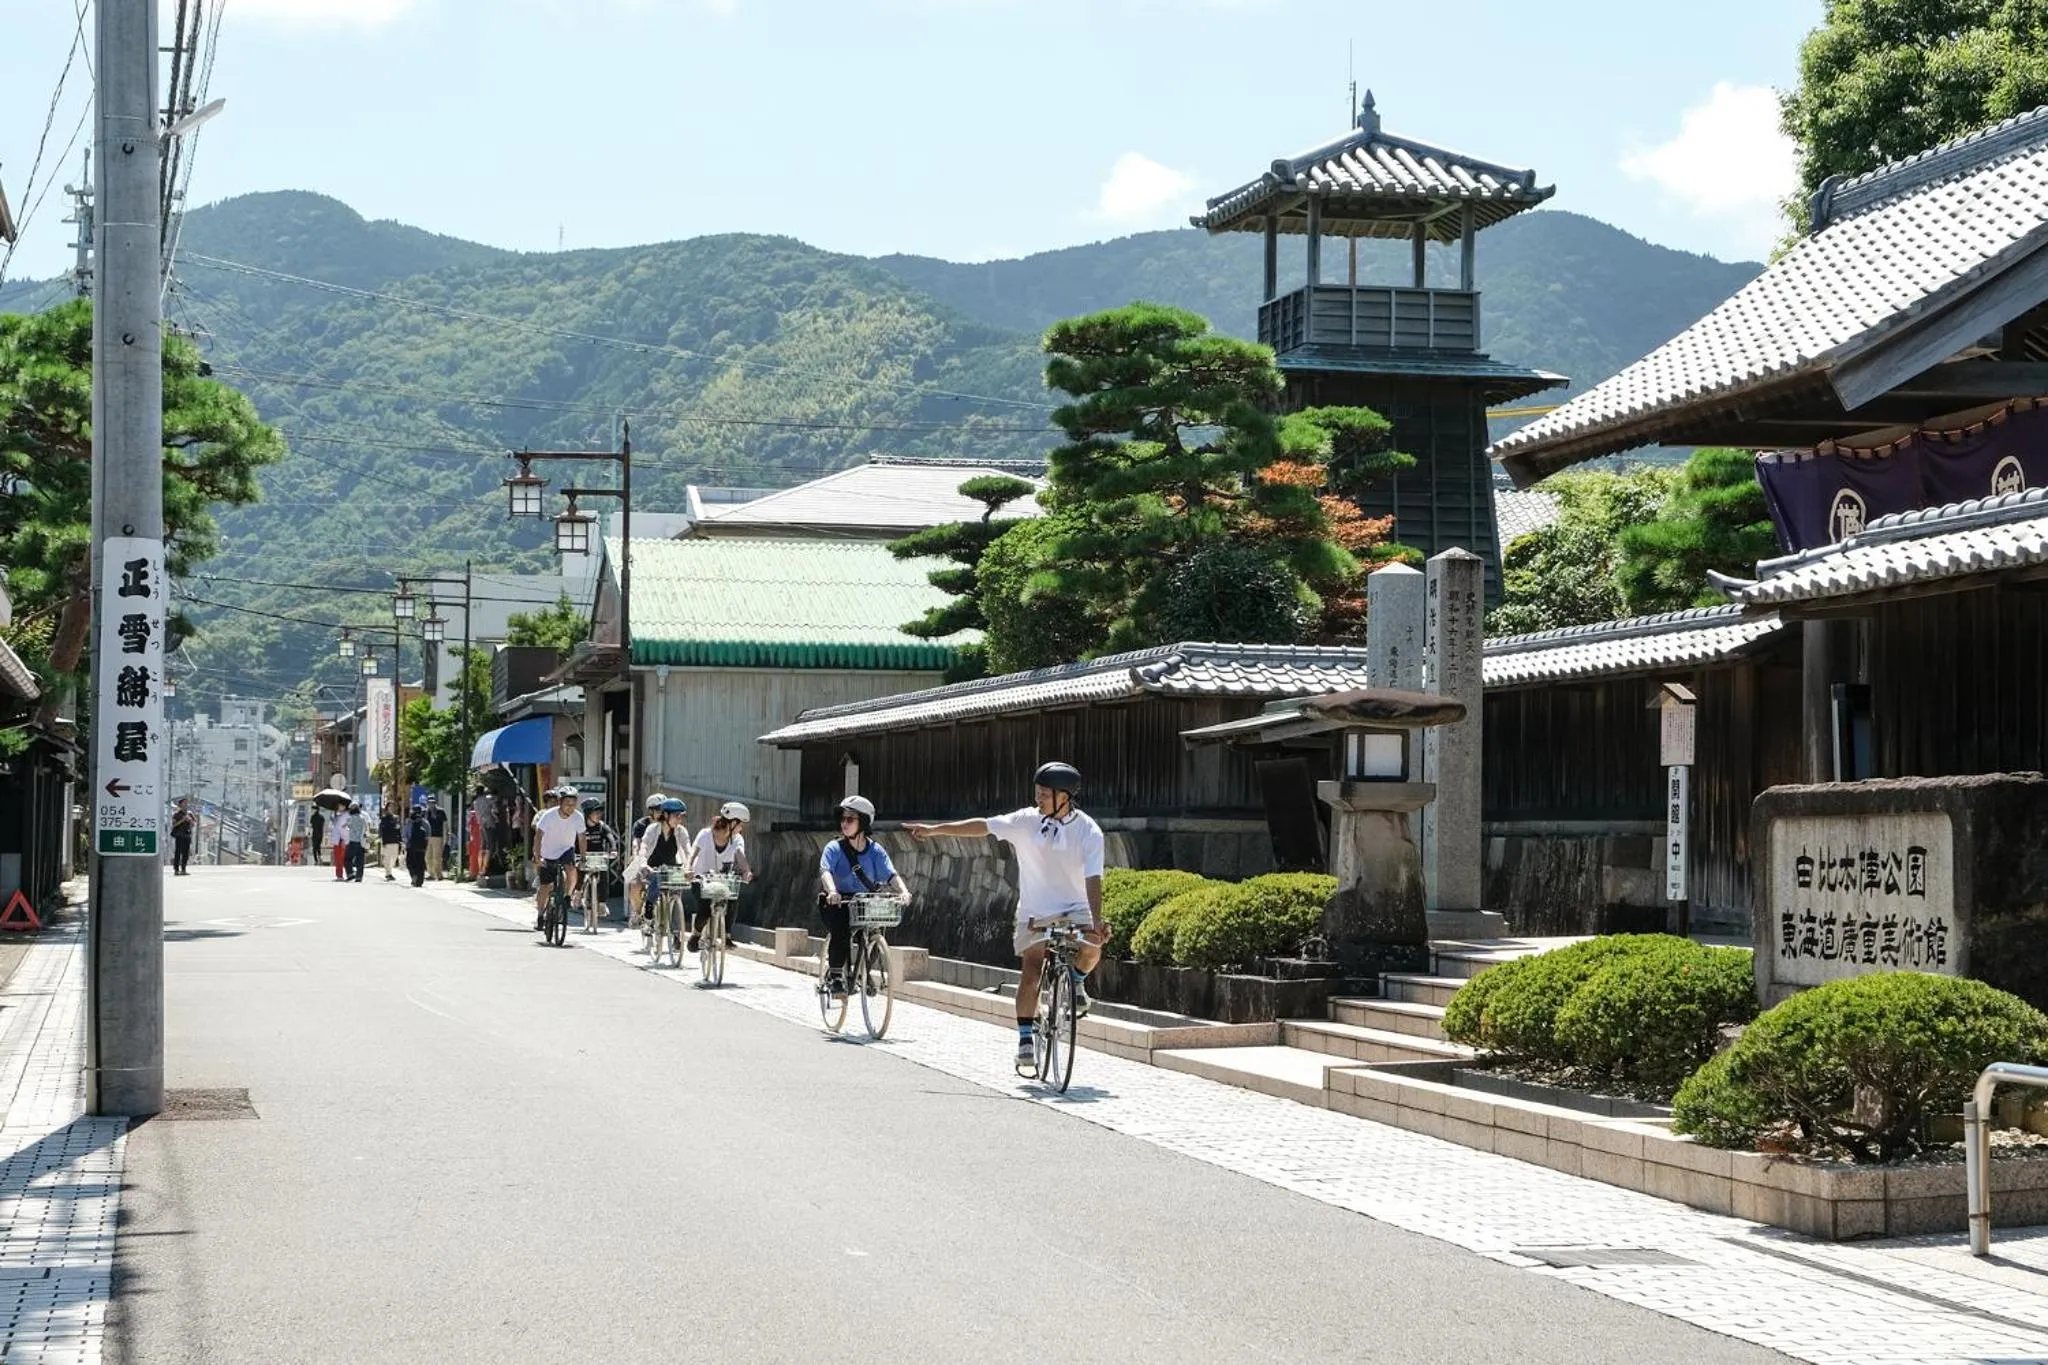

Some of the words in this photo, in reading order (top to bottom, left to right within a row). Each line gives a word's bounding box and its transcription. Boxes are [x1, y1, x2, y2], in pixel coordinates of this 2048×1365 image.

[114, 558, 151, 762] 正雪紺屋
[100, 805, 126, 816] 054
[1796, 845, 1927, 901] 由比本陣公園
[1780, 908, 1949, 968] 東海道廣重美術館
